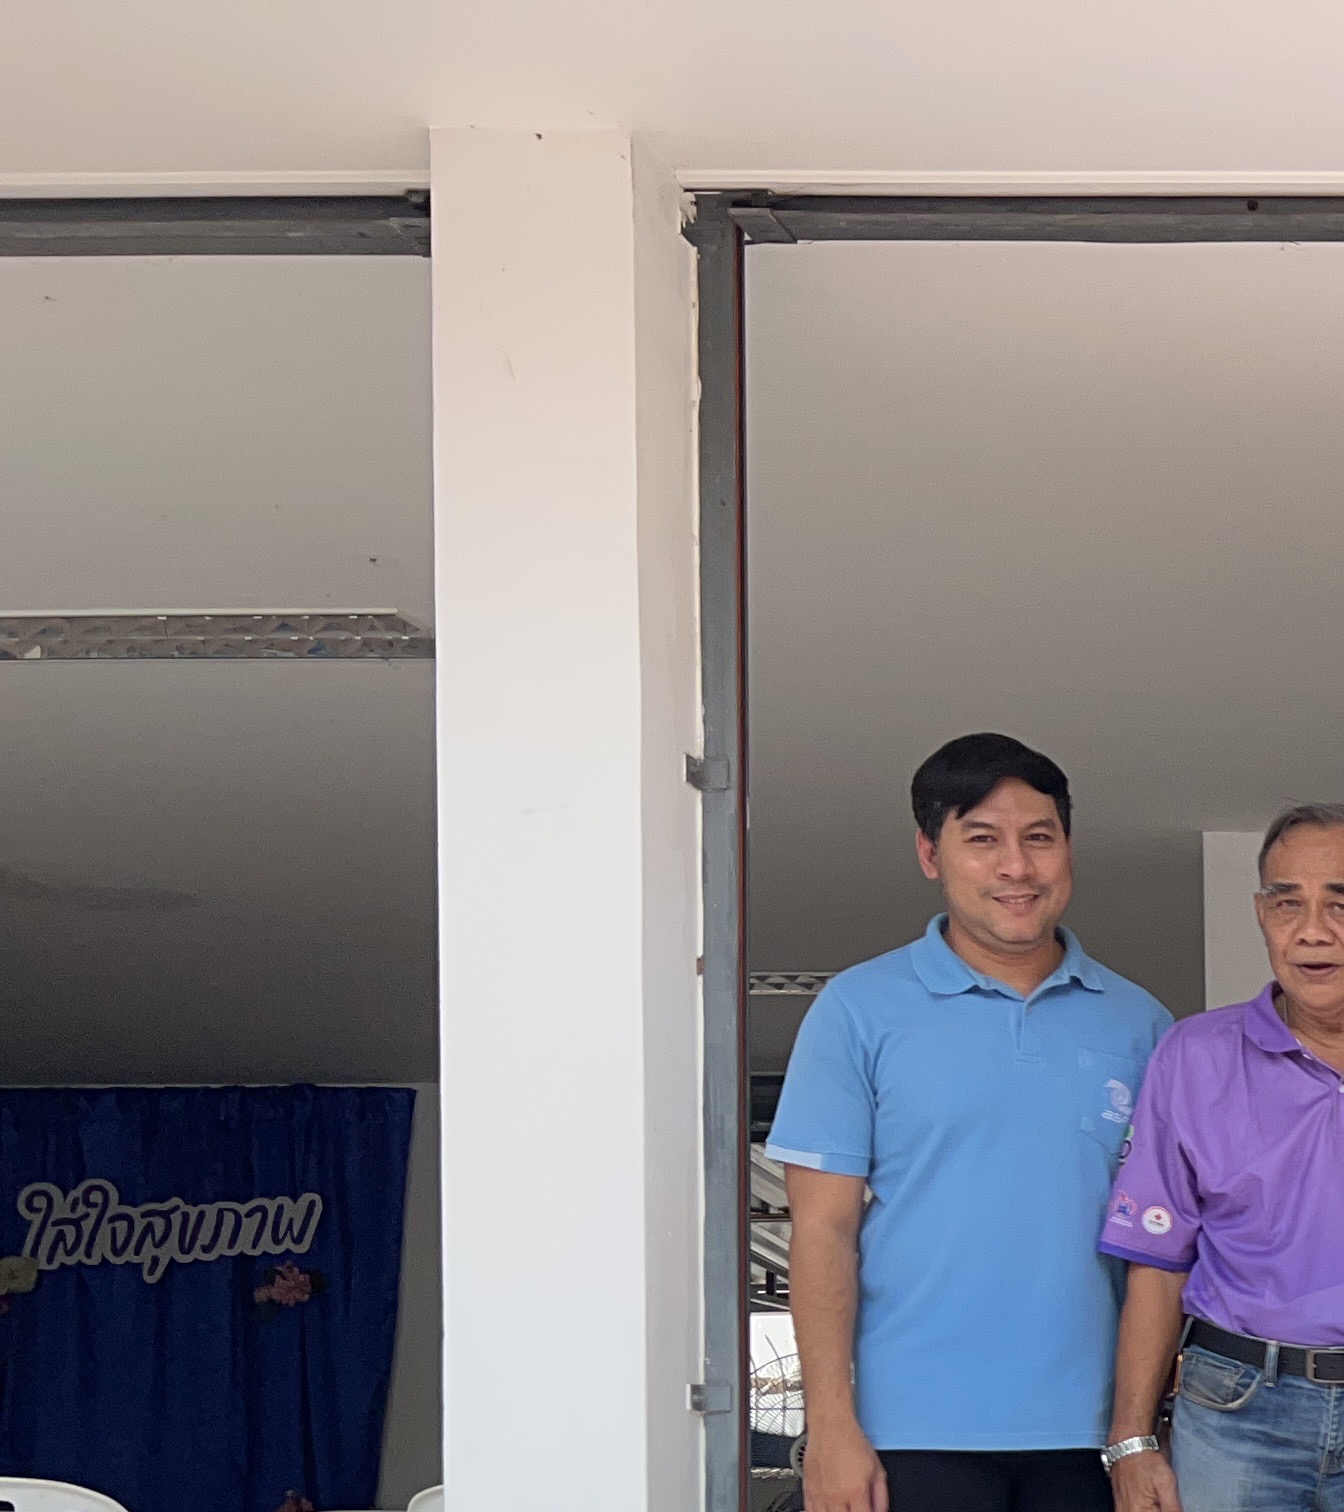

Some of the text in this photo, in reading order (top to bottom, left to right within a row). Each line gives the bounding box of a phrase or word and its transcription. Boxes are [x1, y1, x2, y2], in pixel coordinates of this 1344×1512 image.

[21, 1182, 321, 1280] ใส่ใจสุขภาพ
